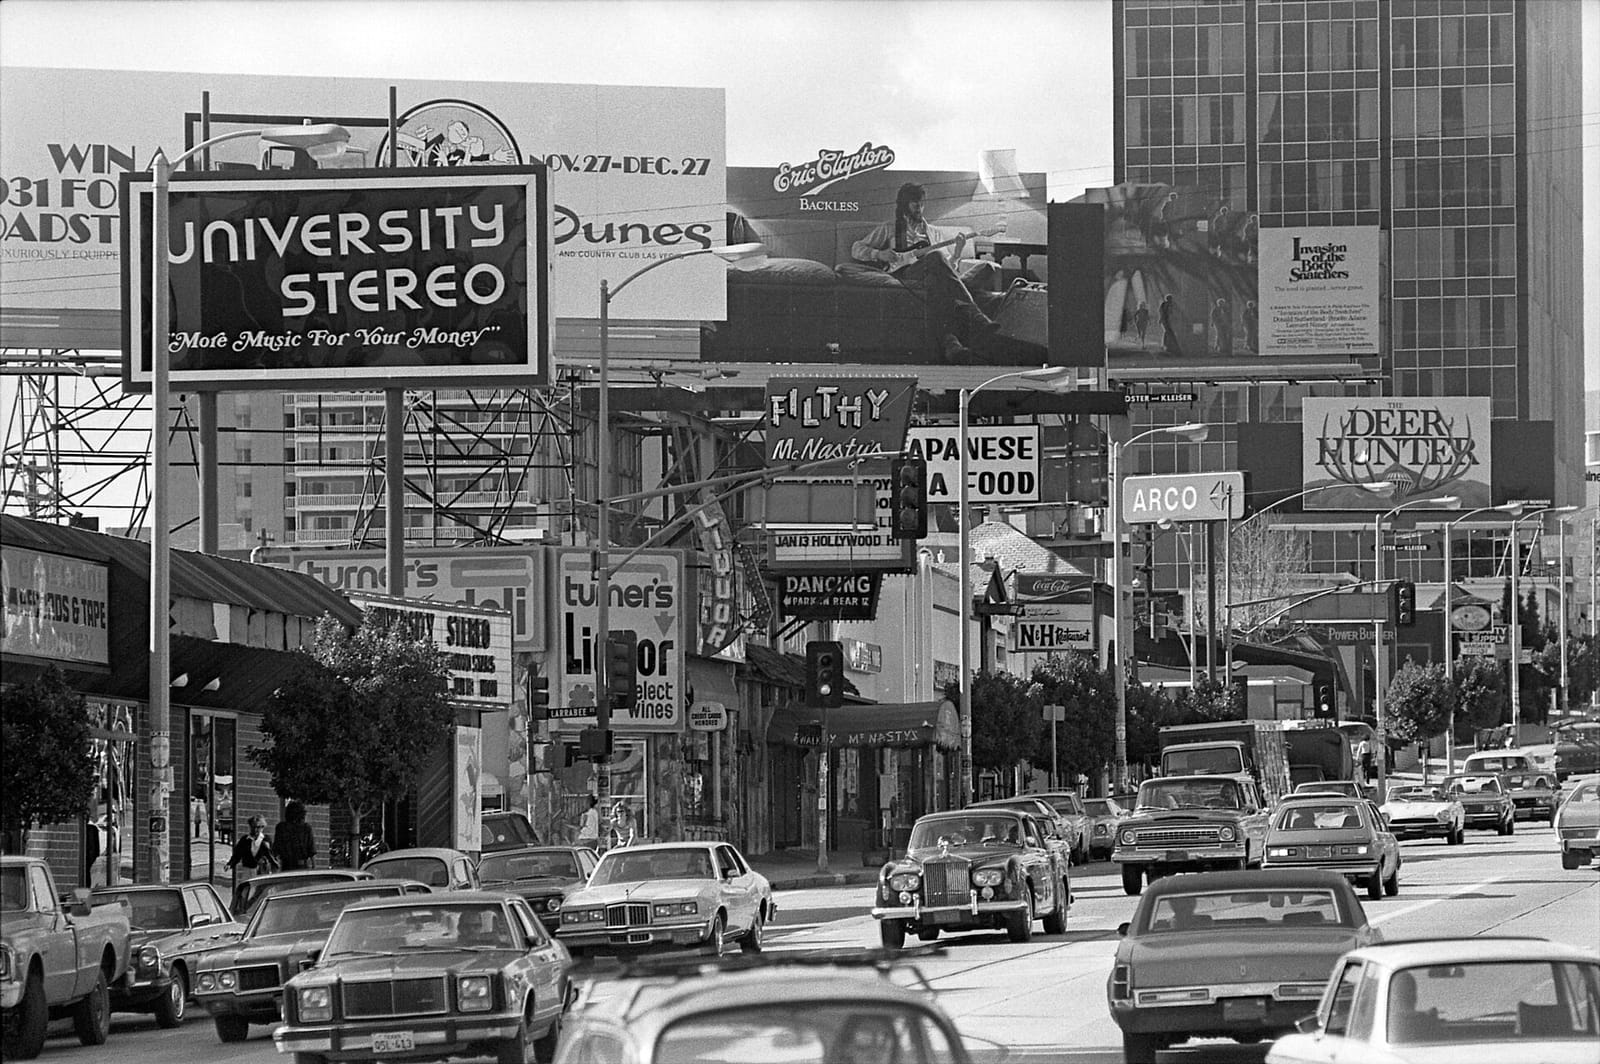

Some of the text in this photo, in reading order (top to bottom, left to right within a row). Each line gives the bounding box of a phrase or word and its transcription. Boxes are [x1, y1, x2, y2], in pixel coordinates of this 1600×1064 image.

[46, 143, 136, 174] WIN
[774, 143, 895, 192] Eric Clapton
[61, 178, 118, 209] FO
[0, 211, 120, 244] ADST
[168, 204, 505, 265] UNIVERSITY
[559, 250, 575, 258] AND
[578, 250, 616, 259] COUNTRY
[619, 251, 640, 259] CLUB
[1292, 236, 1348, 262] Invasion
[1311, 252, 1346, 262] of the
[1288, 267, 1350, 283] Snatchers
[1301, 259, 1336, 272] Body
[281, 263, 505, 317] STEREO
[232, 329, 302, 352] Music
[307, 328, 350, 347] For
[355, 327, 407, 346] Your
[771, 386, 889, 428] FILTHY
[1161, 394, 1193, 402] KLEISER
[1347, 408, 1447, 437] DEER
[908, 436, 1034, 461] APANESE
[1315, 437, 1480, 466] HUNTER
[1133, 485, 1198, 513] ARCO
[775, 536, 797, 547] JAN
[812, 535, 881, 547] HOLLYWOOD
[699, 509, 732, 648] LIQUOR
[786, 576, 871, 593] DANCING
[81, 598, 106, 630] TAPE
[565, 612, 674, 676] Lior
[1329, 627, 1394, 641] POWER BURER
[636, 681, 673, 700] elect
[551, 708, 587, 718] LARRABEE
[629, 700, 673, 719] wines
